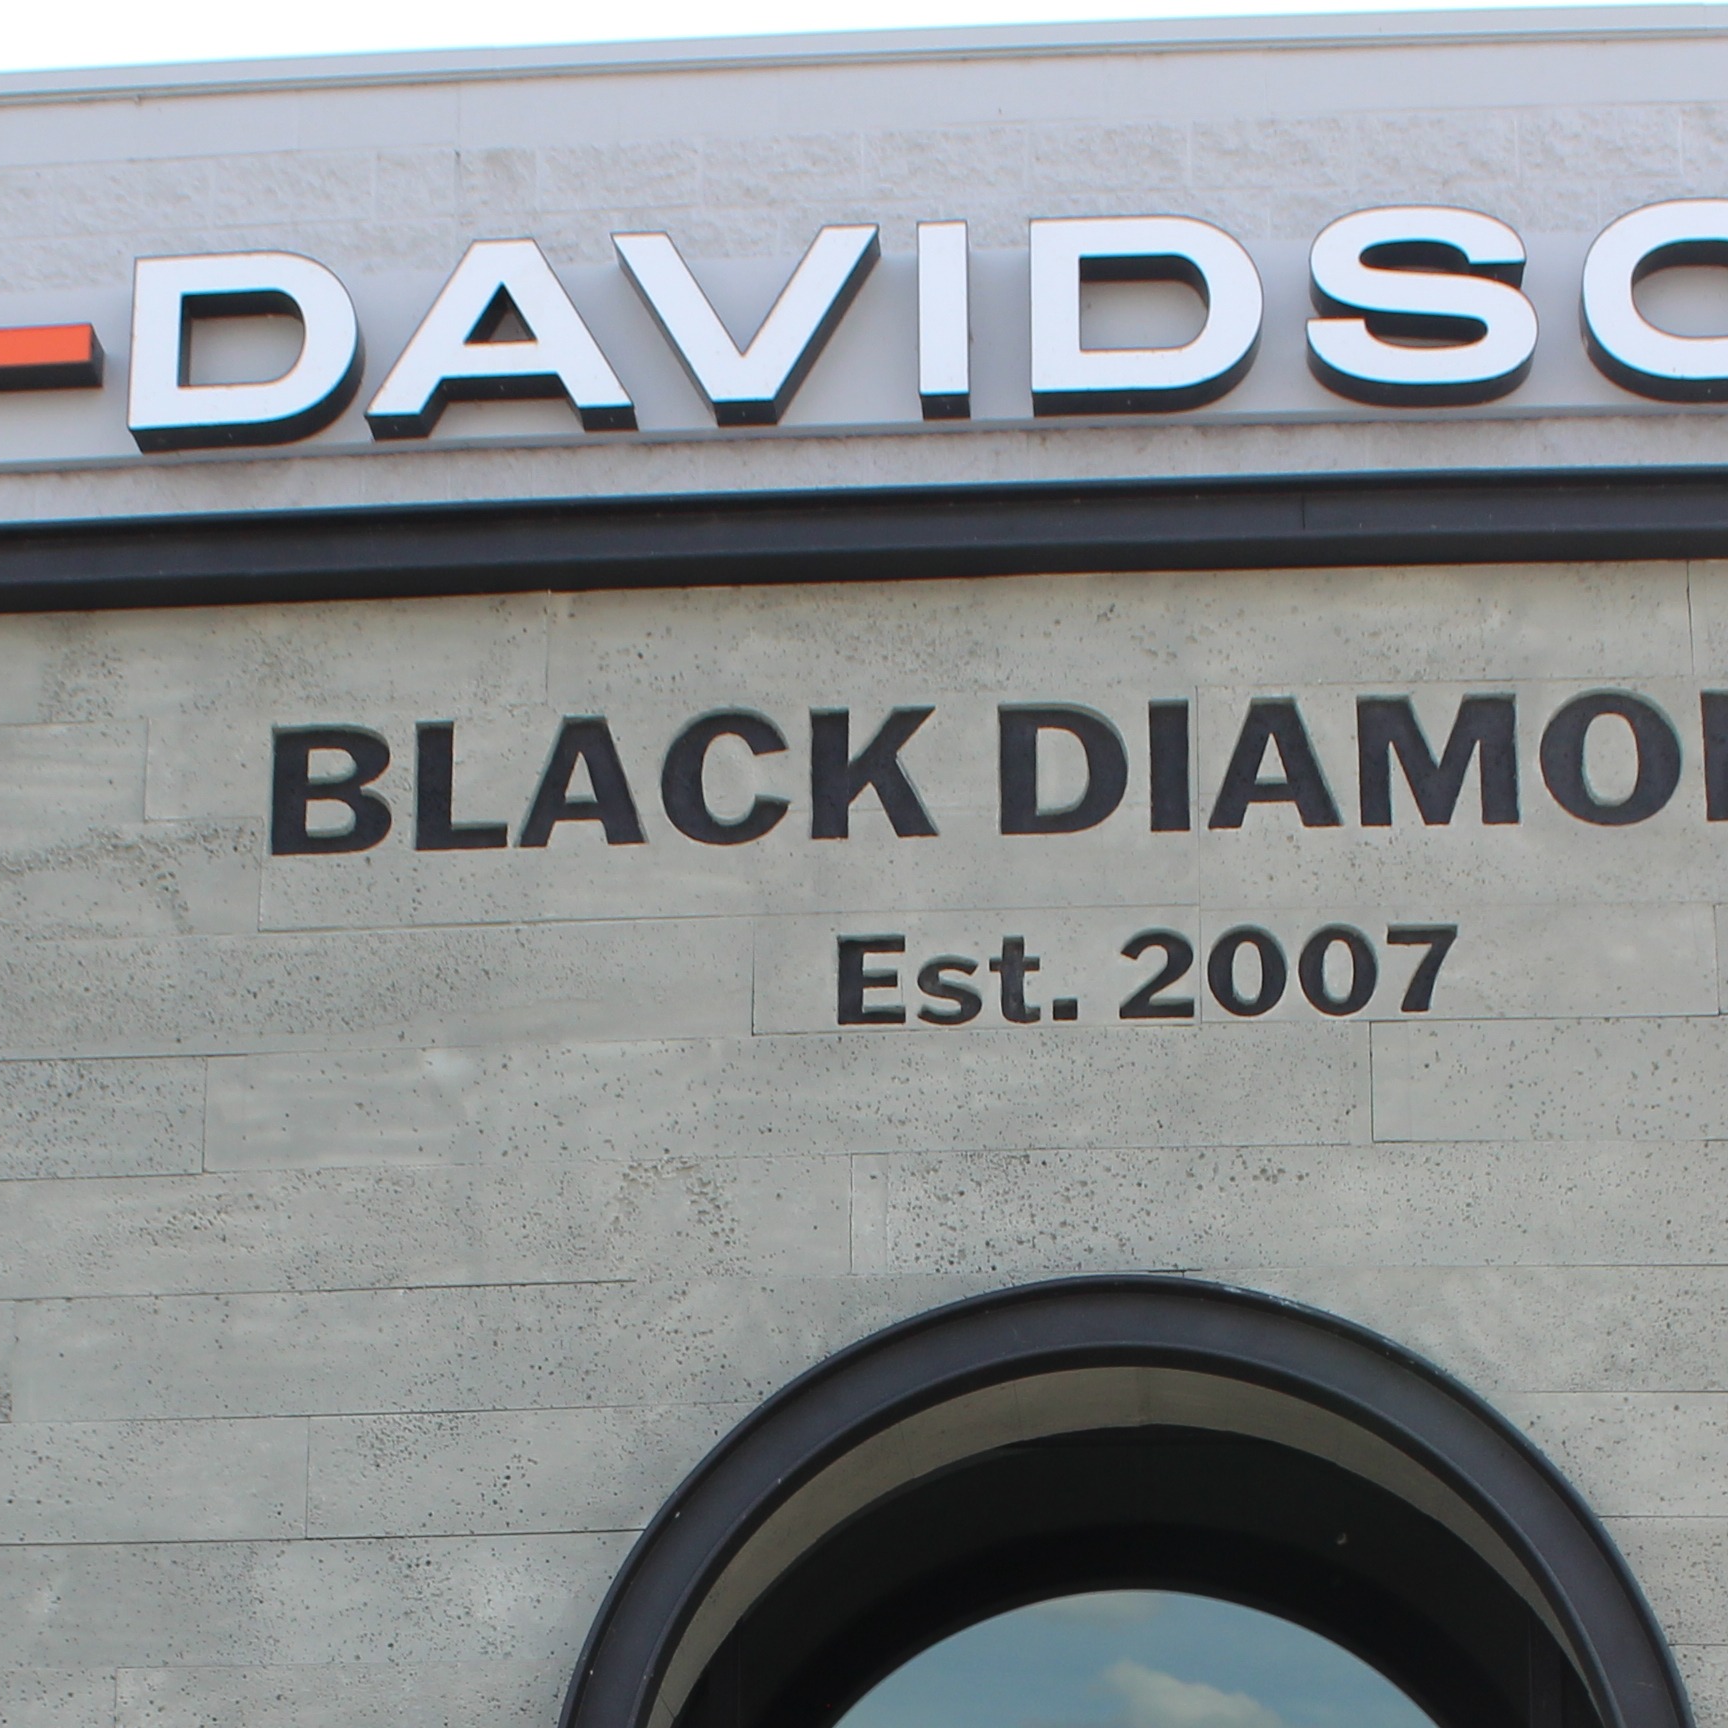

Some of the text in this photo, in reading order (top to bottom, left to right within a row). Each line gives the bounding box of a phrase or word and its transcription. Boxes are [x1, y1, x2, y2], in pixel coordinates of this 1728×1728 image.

[269, 707, 940, 856] BLACK
[836, 923, 1459, 1026] Est. 2007
